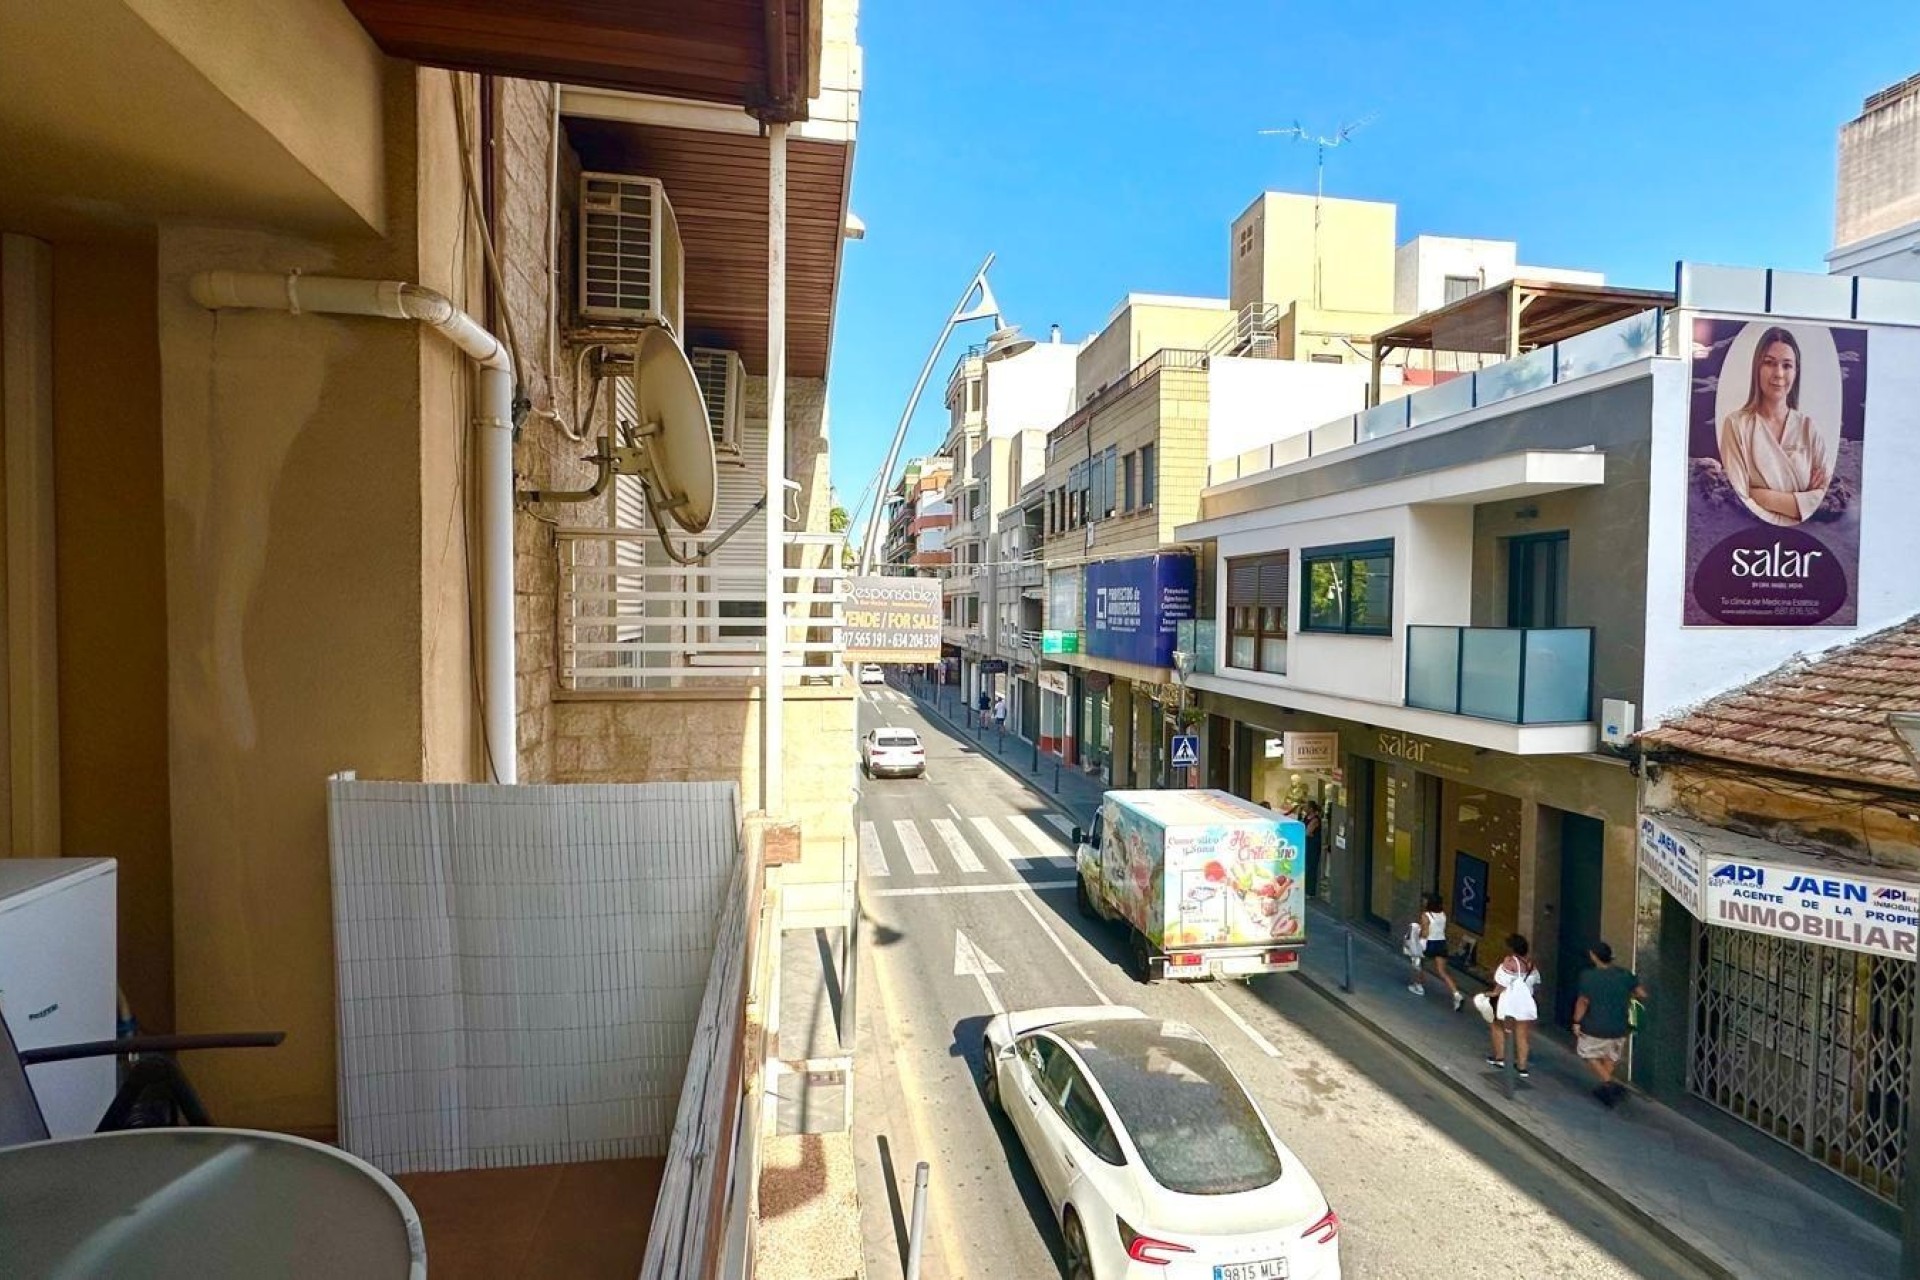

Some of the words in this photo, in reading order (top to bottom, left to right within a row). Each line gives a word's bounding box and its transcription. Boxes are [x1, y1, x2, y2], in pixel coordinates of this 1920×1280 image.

[1731, 541, 1823, 578] salar
[888, 612, 911, 629] FOR
[912, 613, 939, 630] SALE
[872, 632, 887, 648] 191
[1378, 731, 1432, 762] salar
[1641, 817, 1655, 837] API
[1657, 830, 1678, 857] JAEN
[1712, 864, 1765, 886] API
[1782, 875, 1868, 903] JAEN
[1874, 887, 1907, 902] API
[1733, 888, 1784, 904] AGENTE
[1801, 898, 1820, 910] DE
[1835, 905, 1853, 916] LA
[1719, 899, 1916, 954] INMOBILIAR
[1223, 1266, 1256, 1280] 9815
[1260, 1261, 1285, 1278] MLF
